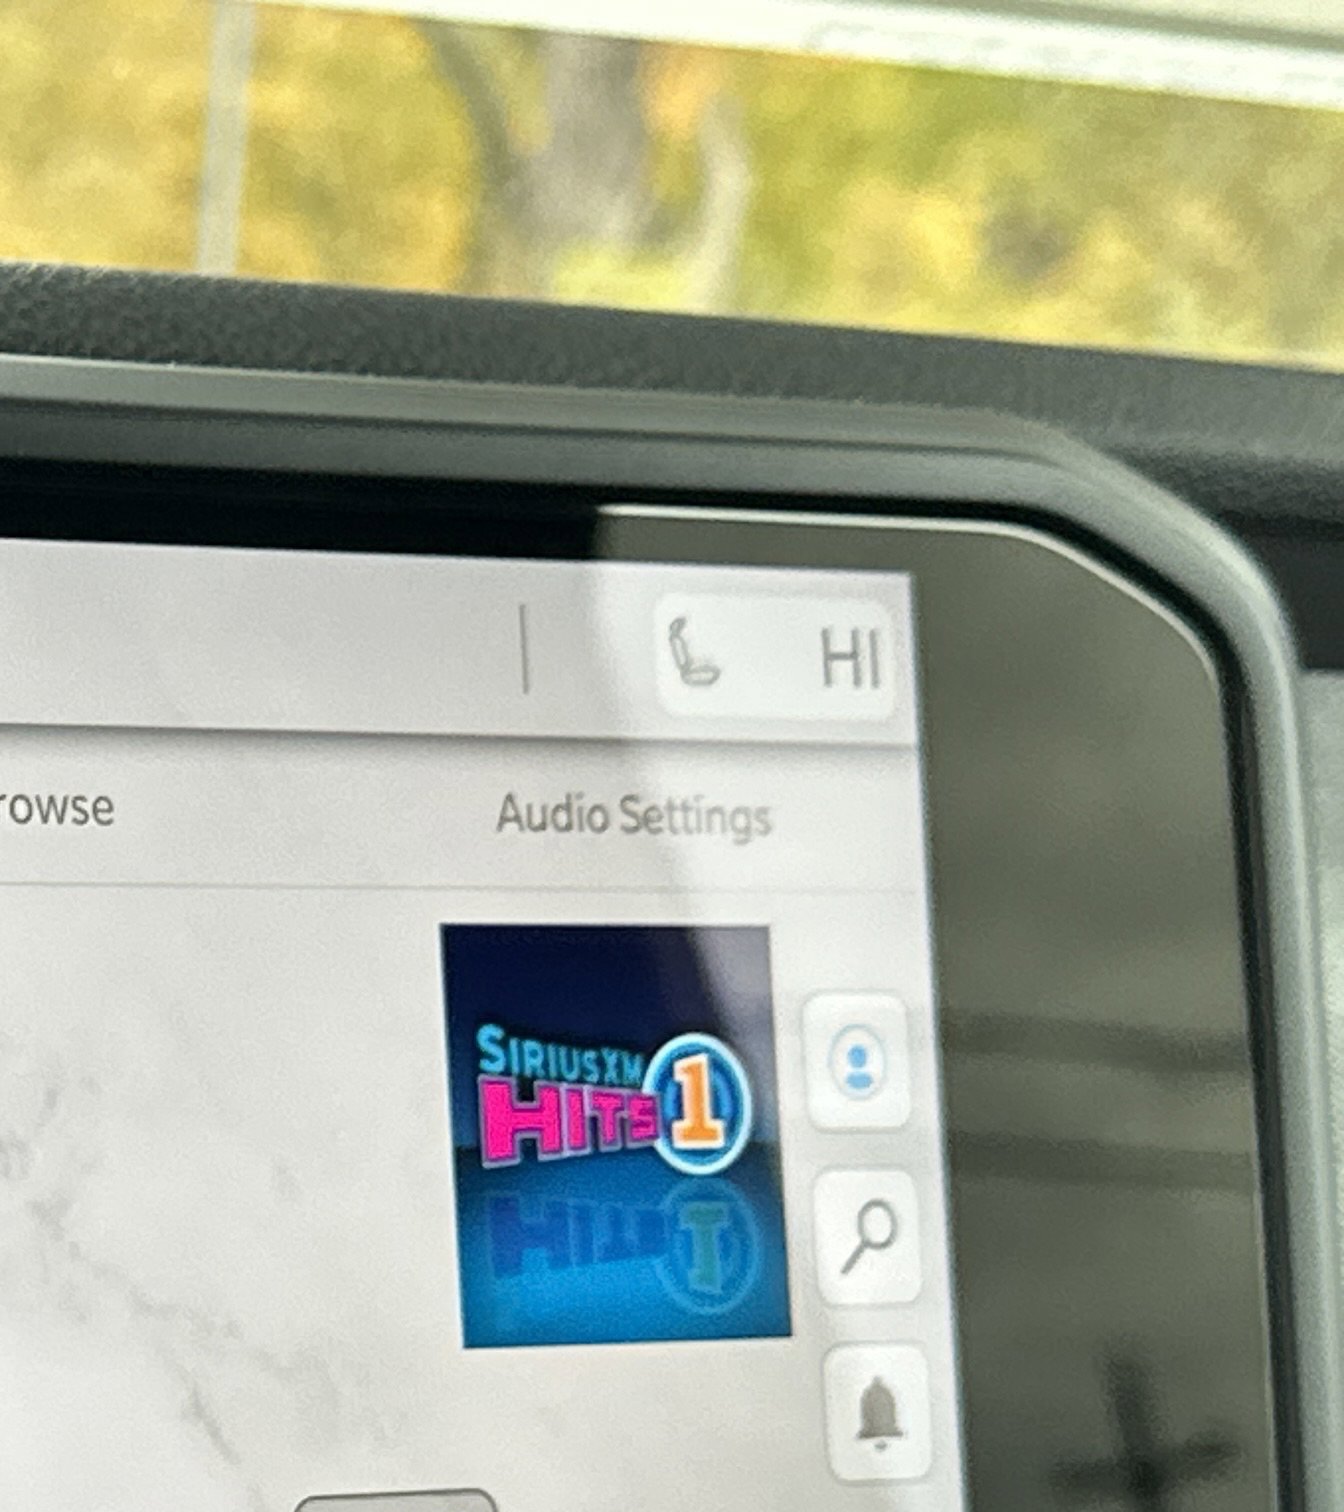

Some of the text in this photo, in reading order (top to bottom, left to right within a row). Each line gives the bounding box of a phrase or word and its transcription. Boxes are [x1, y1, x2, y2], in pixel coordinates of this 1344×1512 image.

[820, 627, 880, 689] HI
[496, 792, 770, 841] Audio Settings
[476, 1074, 662, 1168] HITS
